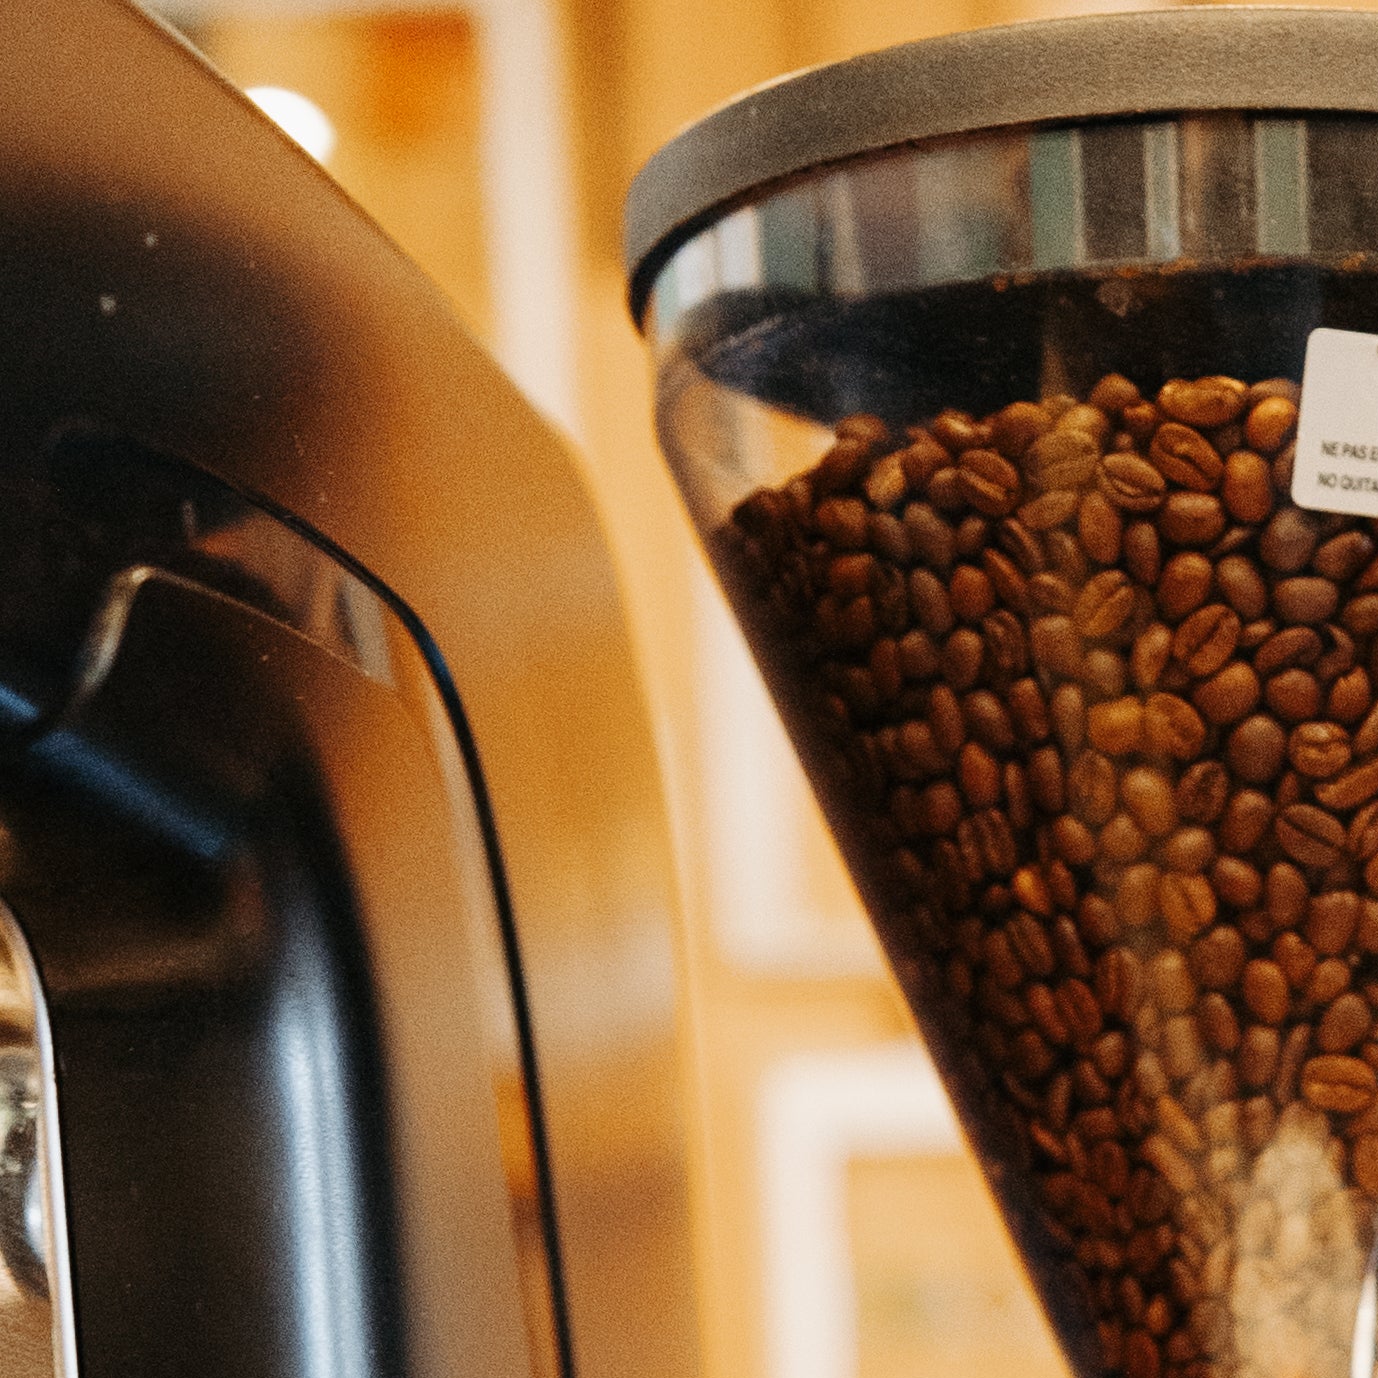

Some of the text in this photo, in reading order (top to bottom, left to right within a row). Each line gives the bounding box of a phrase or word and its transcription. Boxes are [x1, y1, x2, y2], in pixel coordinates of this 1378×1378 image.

[1321, 440, 1338, 457] NE
[1342, 442, 1367, 460] PAS
[1317, 471, 1337, 488] NO
